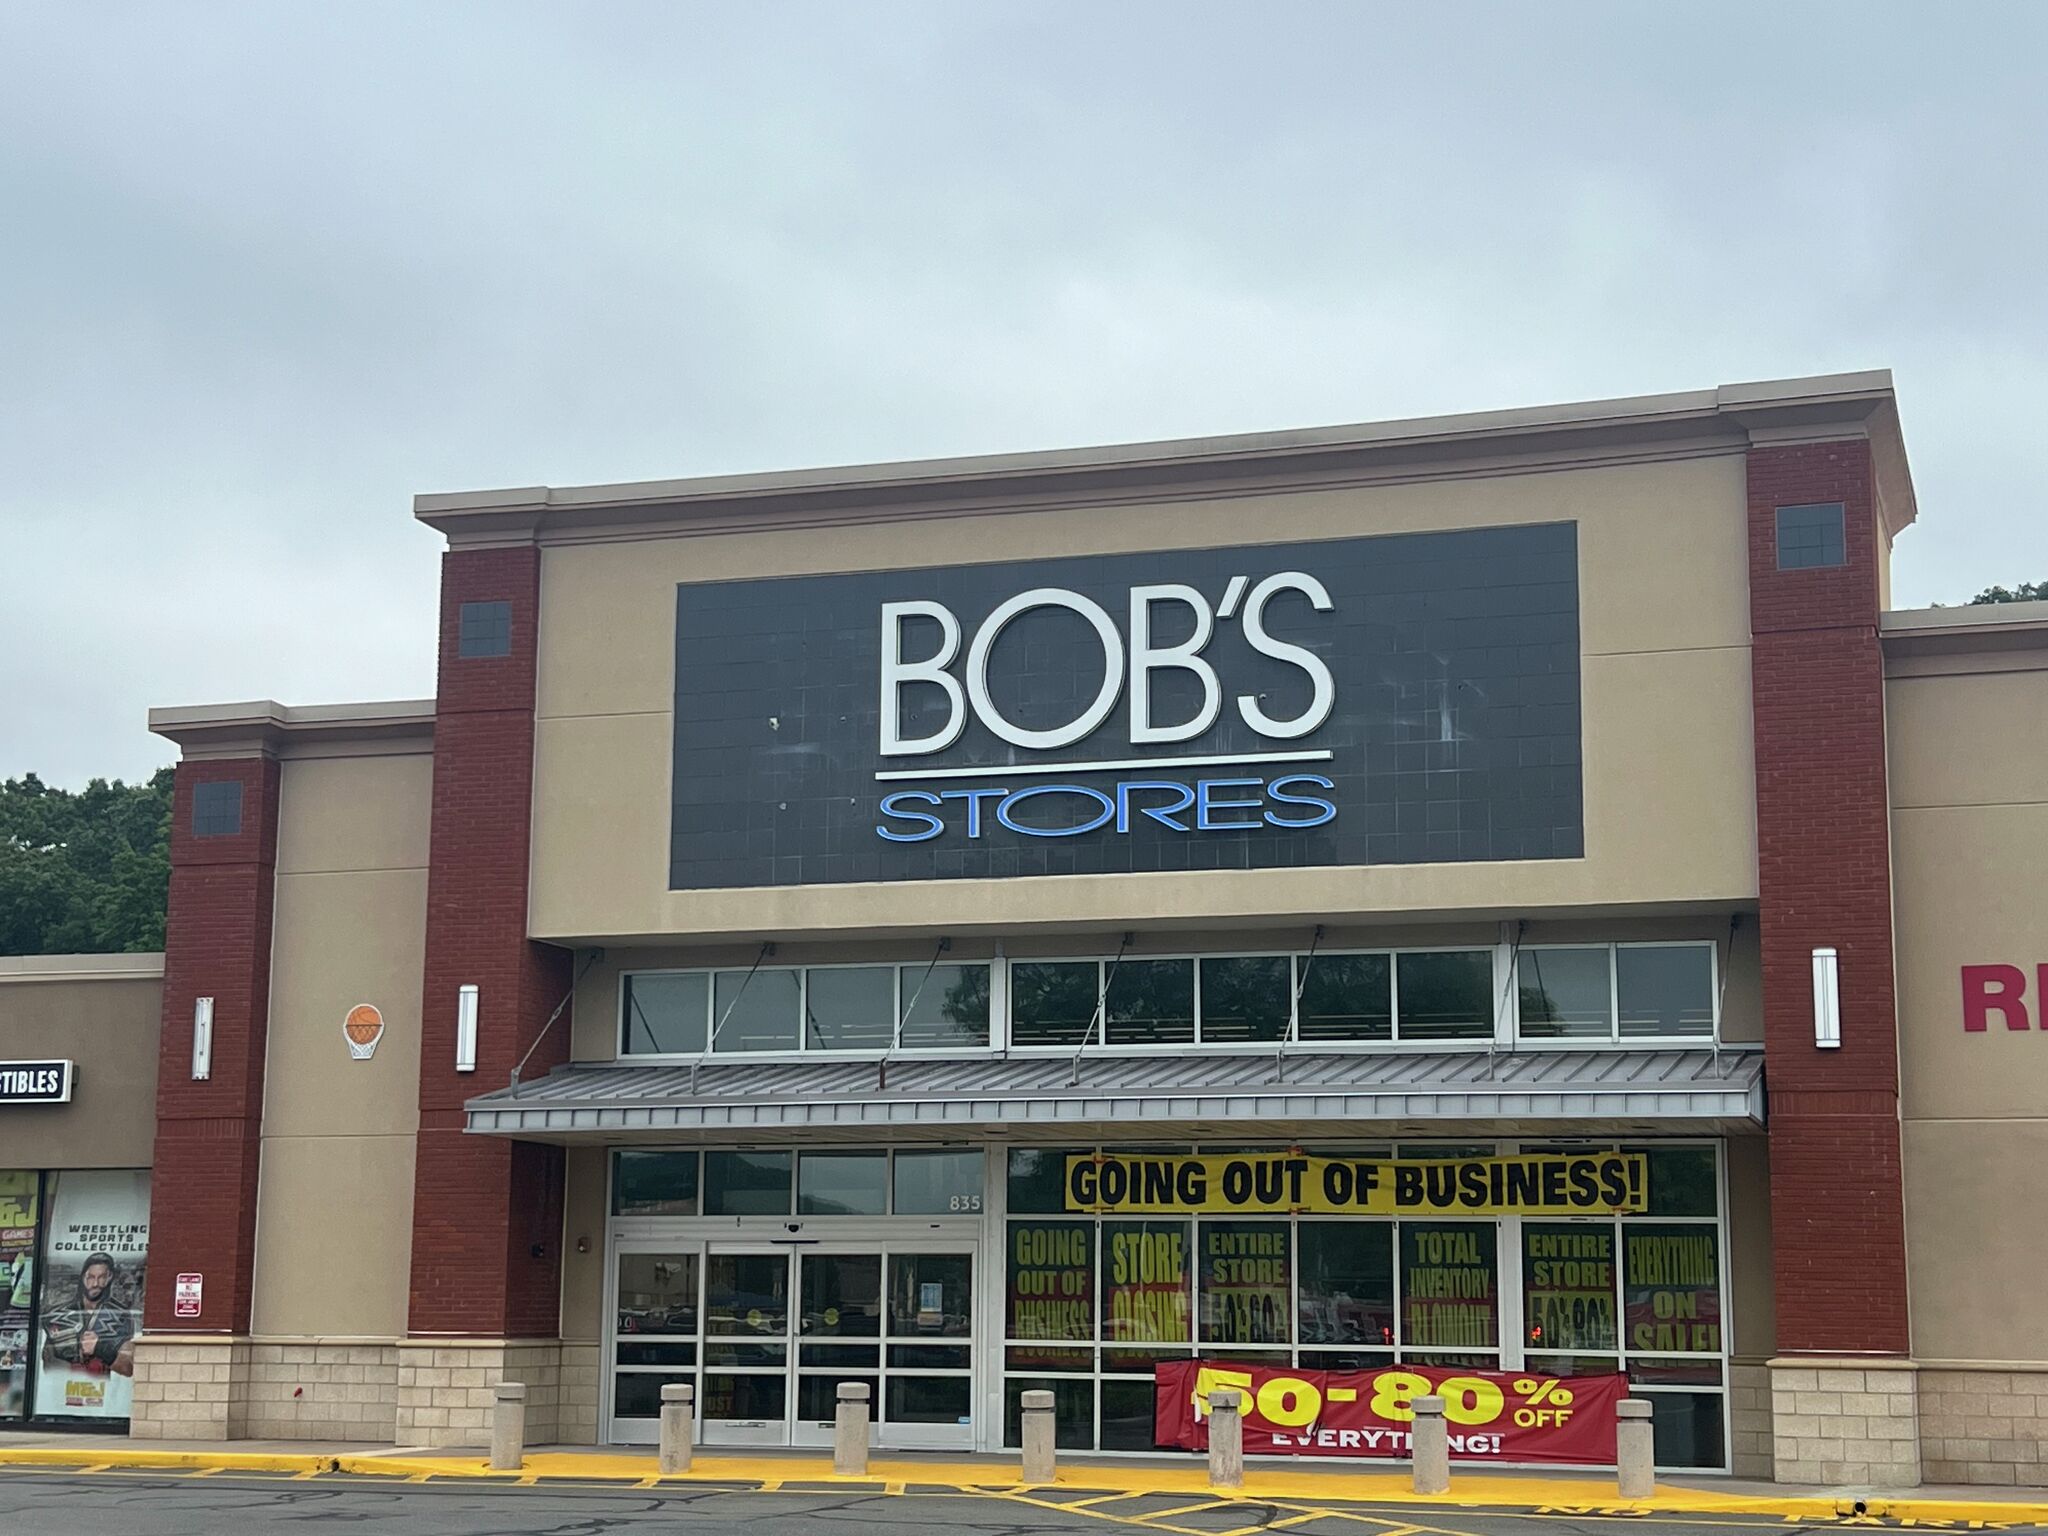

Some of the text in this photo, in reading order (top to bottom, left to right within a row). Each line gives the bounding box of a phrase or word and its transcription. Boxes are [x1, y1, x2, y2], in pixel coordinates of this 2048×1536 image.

[880, 571, 1334, 756] BOB'S
[876, 775, 1337, 842] STORES
[1961, 963, 2048, 1032] R
[0, 1070, 59, 1094] TIBLES
[1071, 1159, 1641, 1207] GOING OUT OF BUSINESS!
[950, 1195, 981, 1210] 835
[79, 1234, 134, 1242] SPORTS
[1016, 1228, 1087, 1266] GOING
[1208, 1232, 1285, 1255] ENTIRE
[1415, 1231, 1481, 1264] TOTAL
[1528, 1234, 1611, 1258] ENTIRE
[1113, 1231, 1183, 1285] STORE
[1213, 1258, 1284, 1283] STORE
[1628, 1236, 1716, 1285] EVERYTHING
[1017, 1270, 1087, 1296] OUT OF
[1409, 1267, 1489, 1299] INVENTORY
[1533, 1260, 1611, 1287] STORE
[1653, 1291, 1698, 1320] ON
[1513, 1408, 1574, 1428] OFF
[1271, 1429, 1501, 1454] EVERYTNG!
